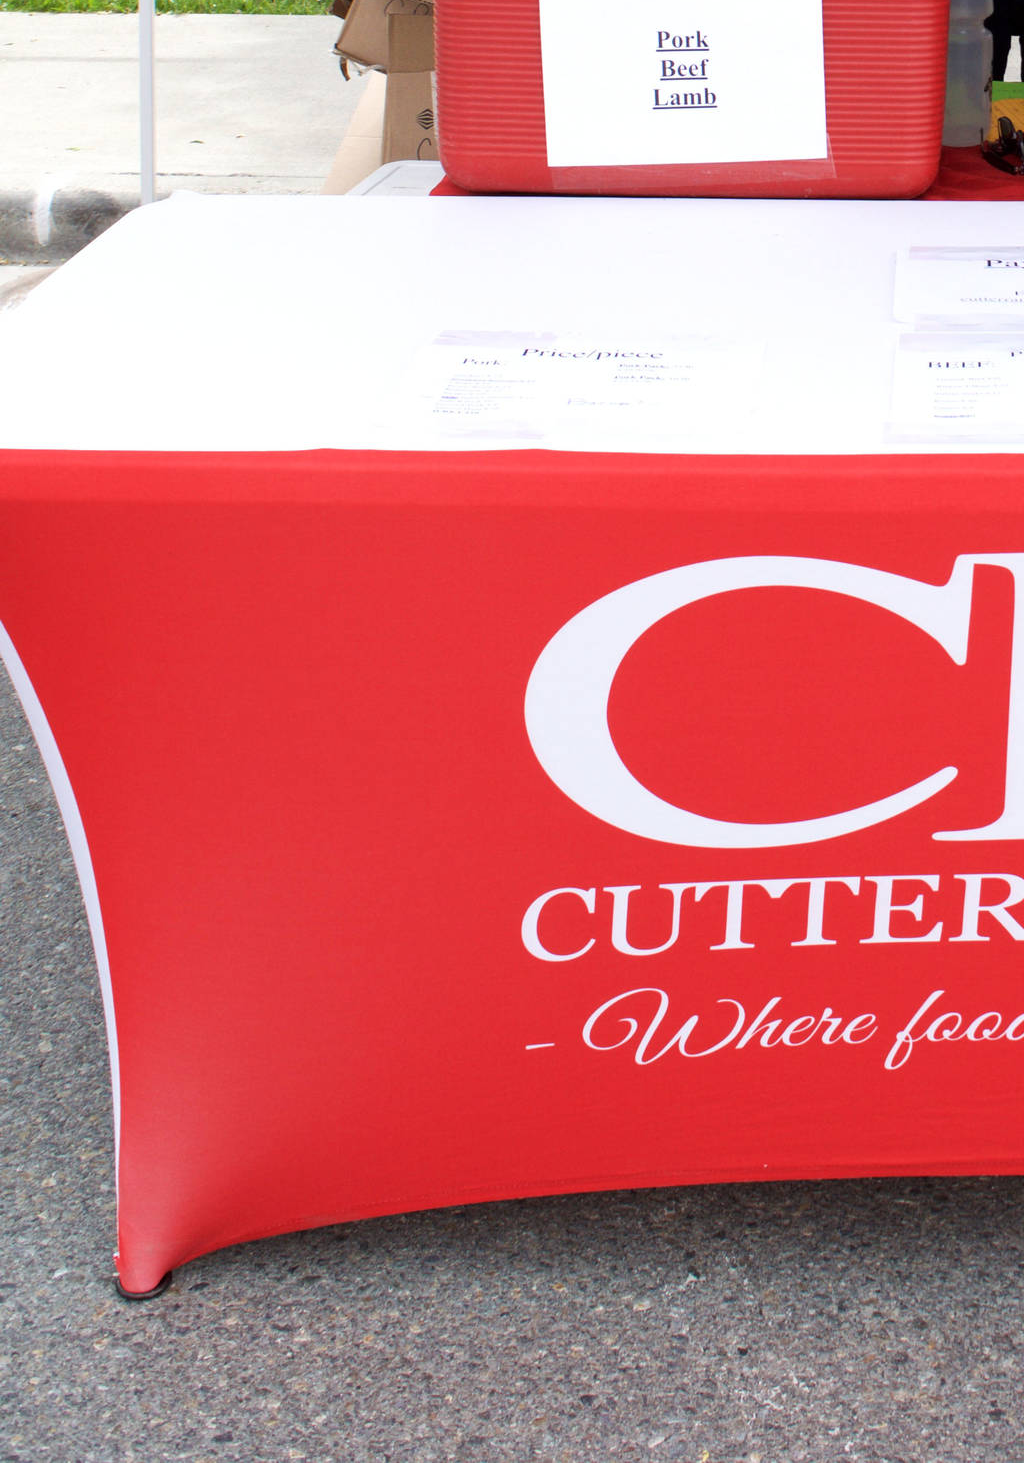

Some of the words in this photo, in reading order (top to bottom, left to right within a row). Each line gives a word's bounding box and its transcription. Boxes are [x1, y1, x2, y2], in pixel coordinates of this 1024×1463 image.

[656, 30, 710, 51] Pork
[660, 58, 710, 79] Beef
[653, 87, 718, 108] Lamb
[521, 347, 664, 360] Price/piece
[581, 987, 878, 1066] Where
